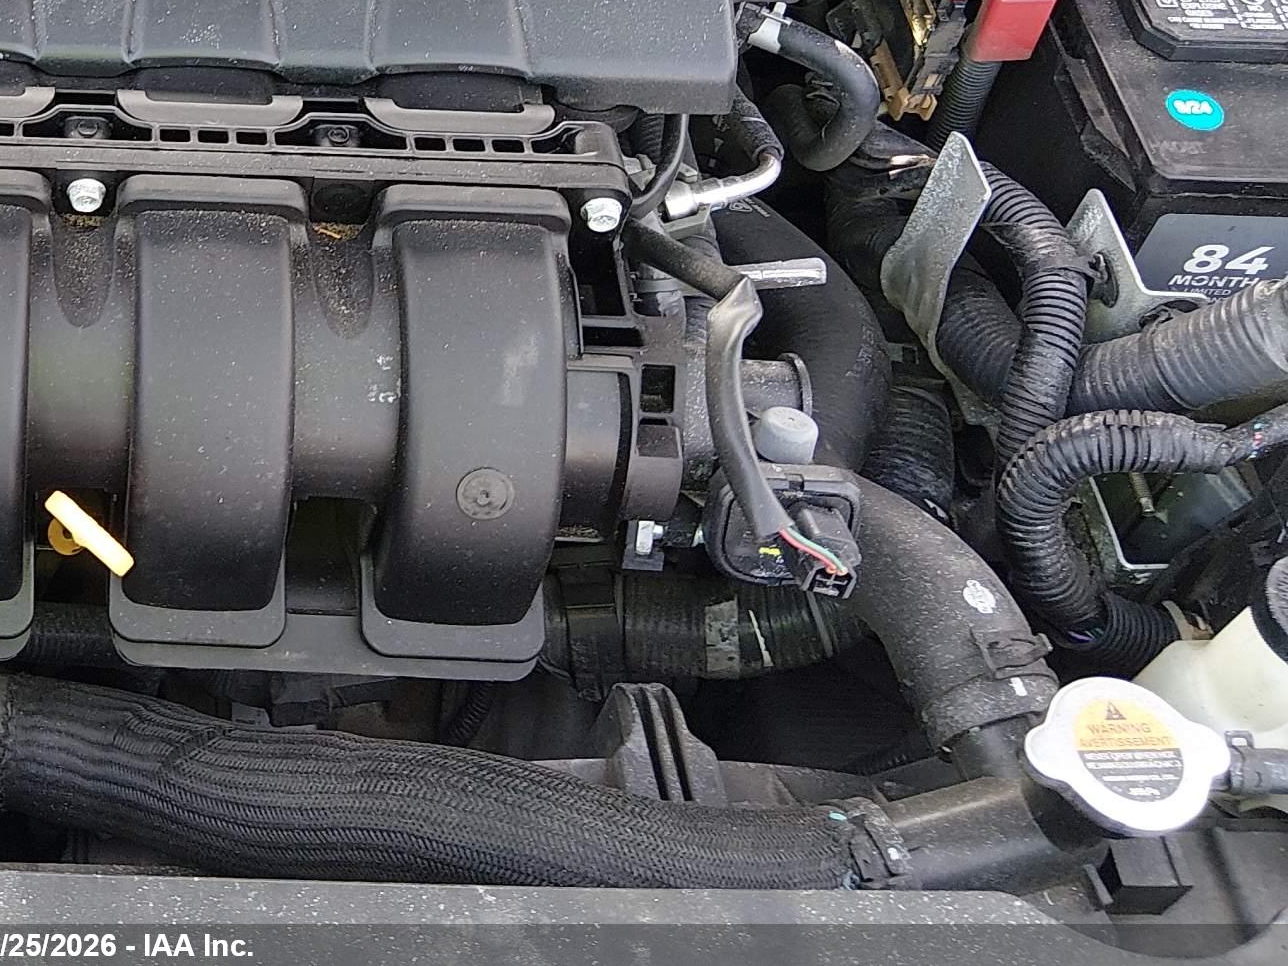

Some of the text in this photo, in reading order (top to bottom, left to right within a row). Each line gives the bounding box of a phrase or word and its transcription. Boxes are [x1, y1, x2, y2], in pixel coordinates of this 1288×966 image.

[1183, 244, 1275, 275] 84
[1168, 275, 1260, 288] MONTH
[1184, 288, 1231, 296] LIMITED
[1086, 723, 1152, 734] WARNING
[1079, 736, 1175, 747] AVERTISSEMENT
